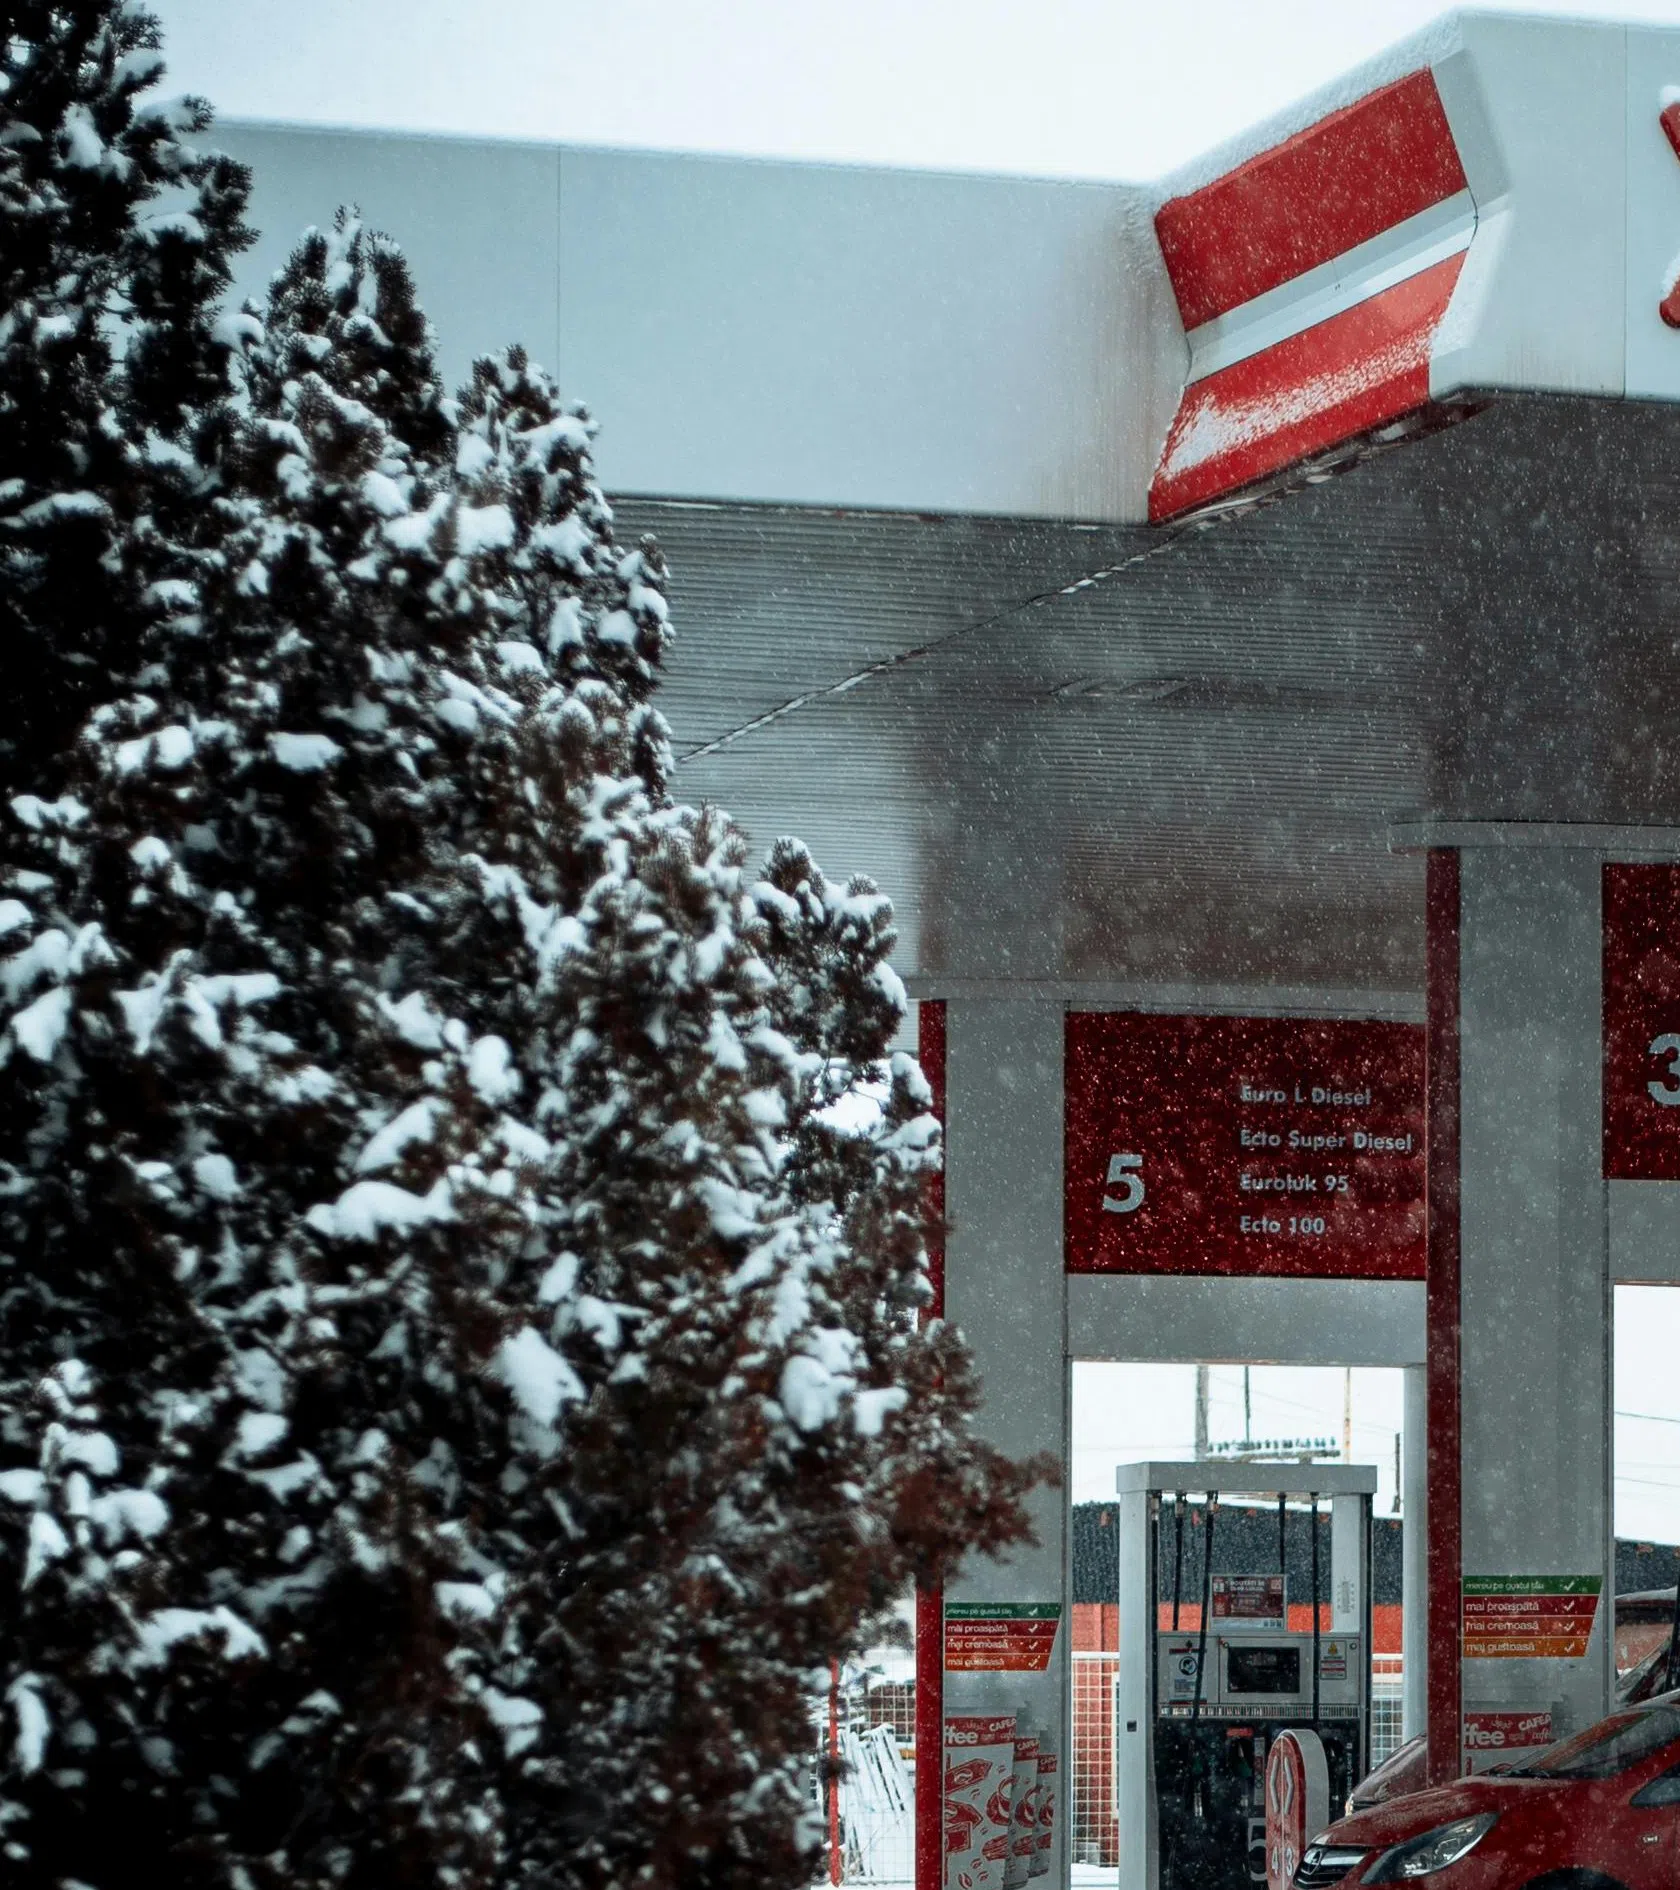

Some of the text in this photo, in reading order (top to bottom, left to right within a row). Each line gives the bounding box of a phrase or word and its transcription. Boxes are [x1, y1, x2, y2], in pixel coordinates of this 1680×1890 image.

[1240, 1085, 1372, 1106] Euro L Diesel
[1240, 1128, 1412, 1151] Ecto Super Diesel
[1101, 1153, 1146, 1213] 5
[1239, 1173, 1349, 1193] Euroluk 95
[1240, 1216, 1326, 1236] Ecto 100
[1466, 1601, 1485, 1611] mai
[1270, 1846, 1280, 1877] 4
[1285, 1847, 1294, 1877] 3
